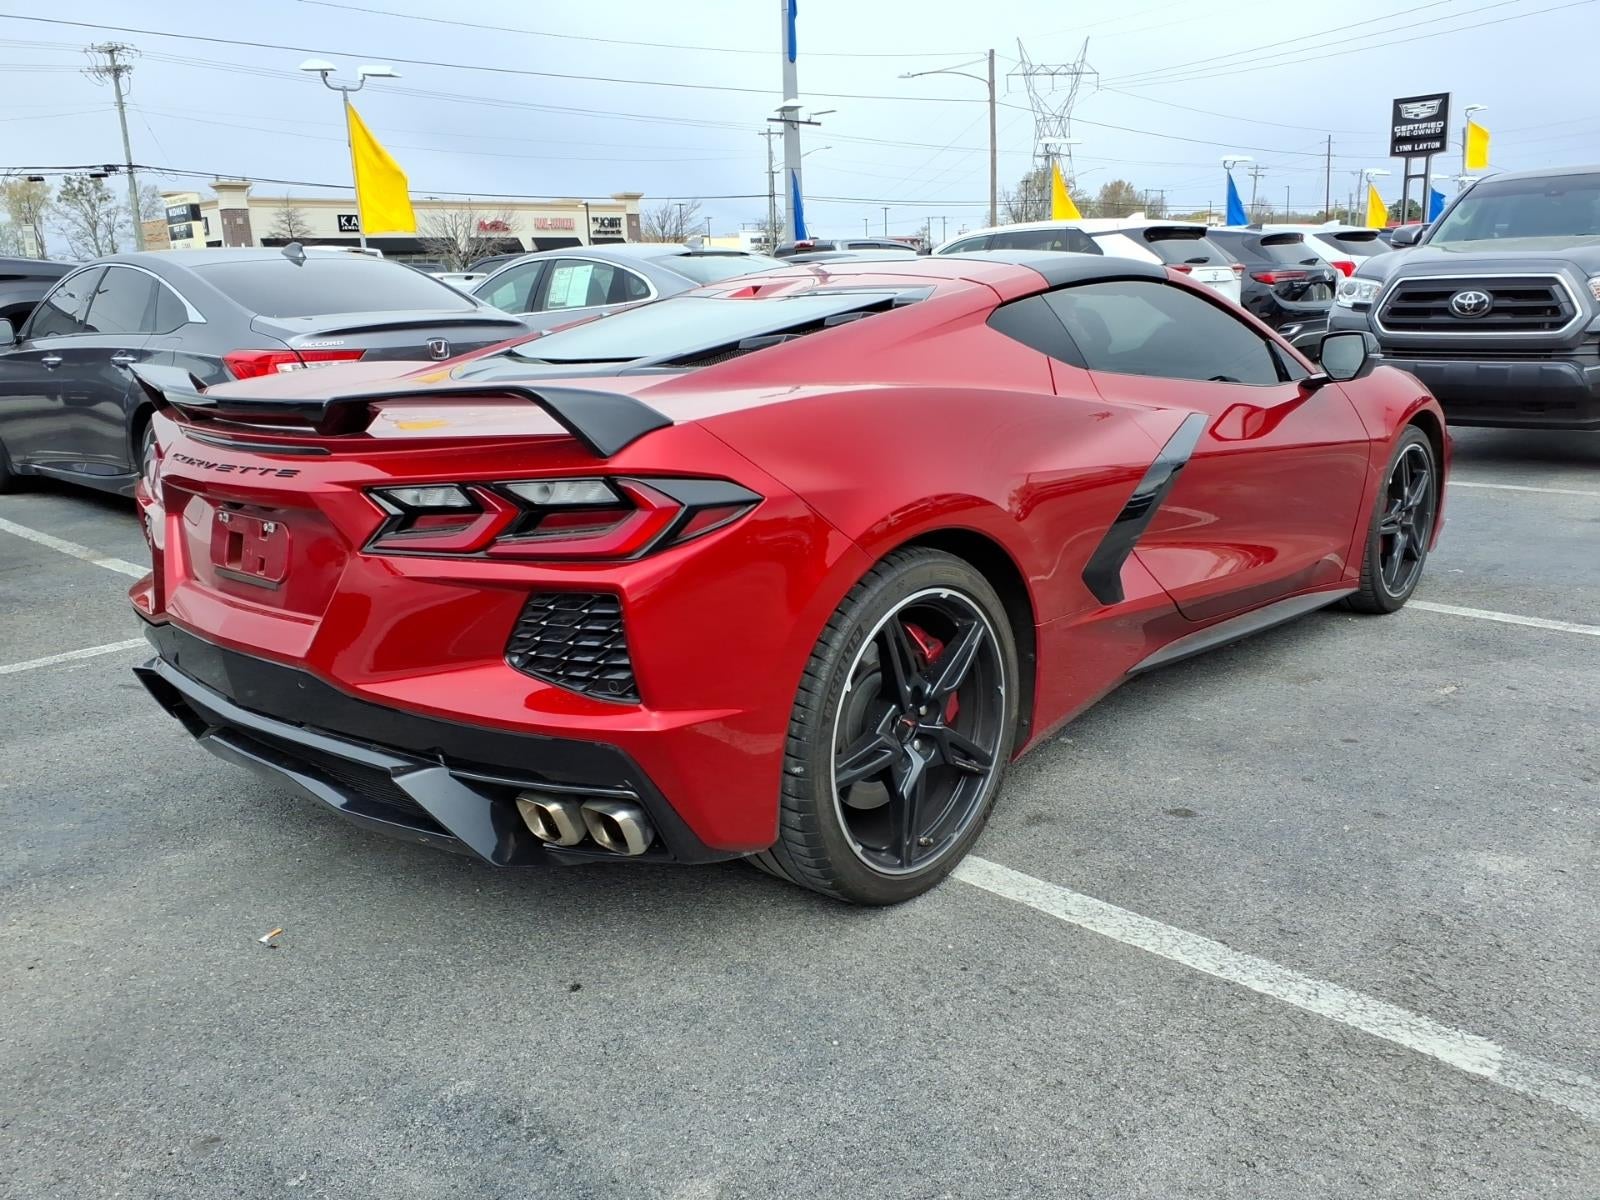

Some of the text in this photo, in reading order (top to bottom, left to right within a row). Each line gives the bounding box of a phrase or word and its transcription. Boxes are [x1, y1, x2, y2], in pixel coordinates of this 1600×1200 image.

[1394, 121, 1444, 133] CERTIFIED
[1396, 127, 1441, 137] PRE-OWNED
[1395, 141, 1440, 152] LYNN LAYTON
[340, 216, 359, 226] KA
[300, 340, 345, 348] ACCORD
[172, 453, 301, 478] CORVETTE
